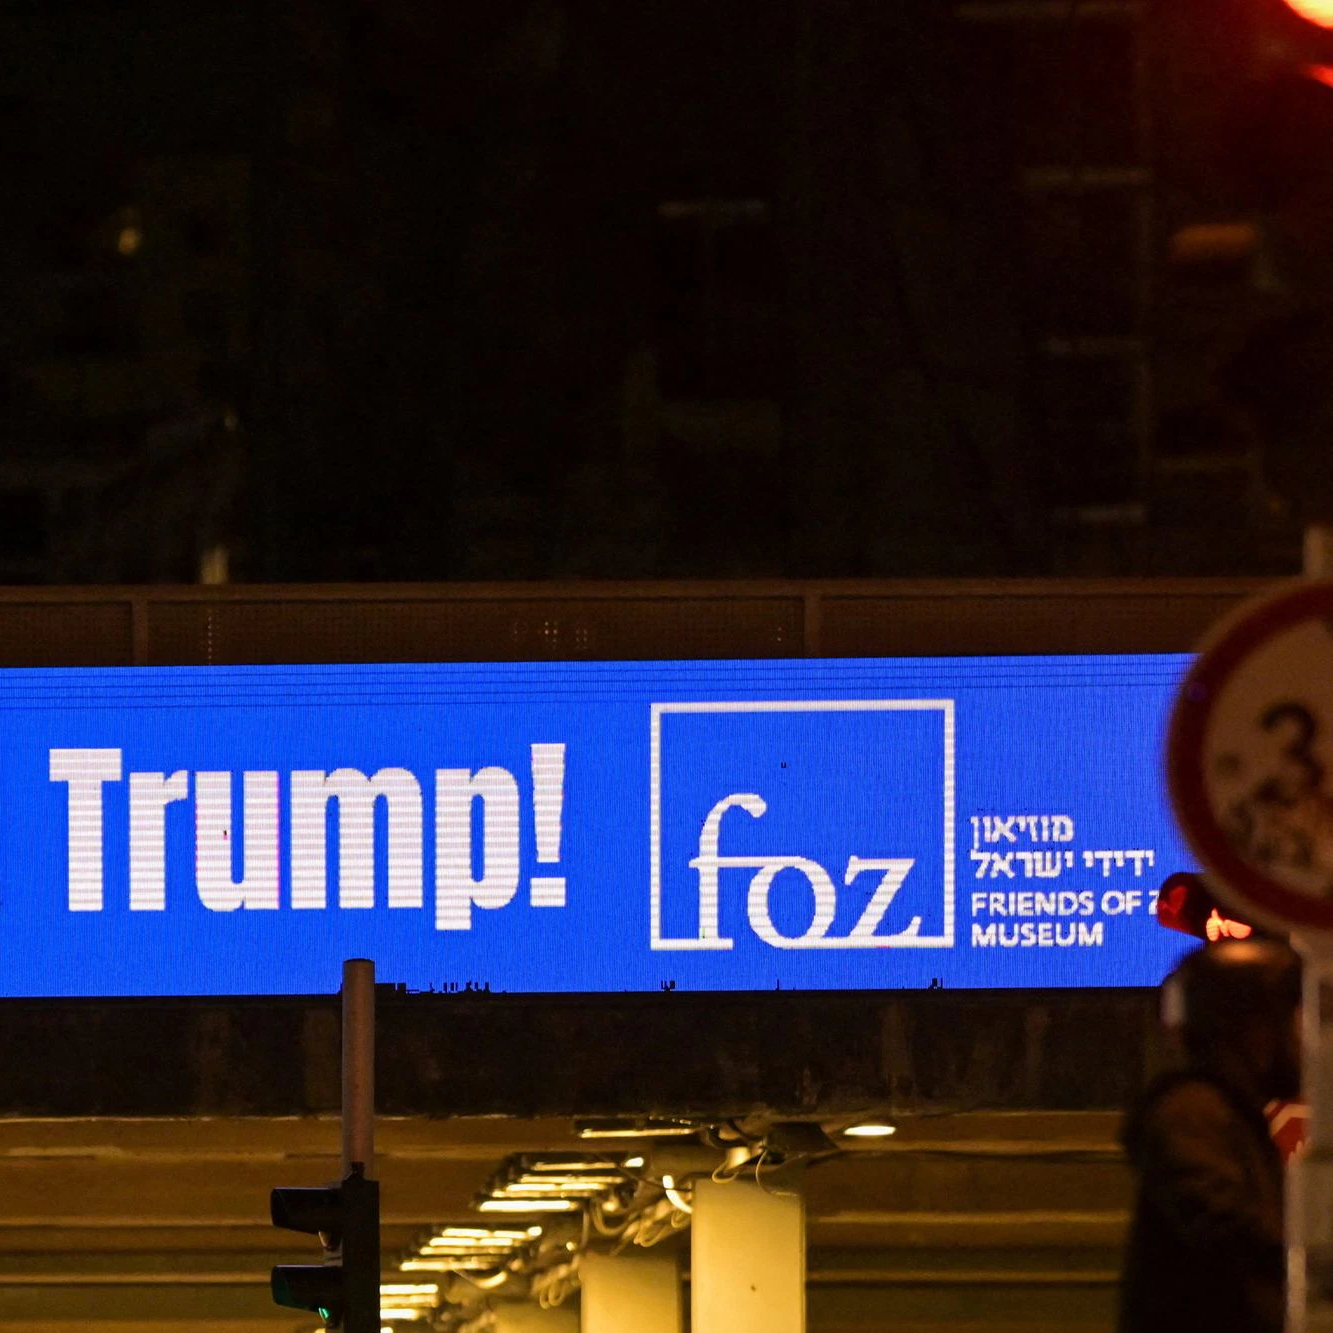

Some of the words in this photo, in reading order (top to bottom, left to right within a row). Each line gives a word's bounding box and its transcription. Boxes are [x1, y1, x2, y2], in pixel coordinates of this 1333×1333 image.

[49, 743, 567, 931] Trump!
[970, 815, 1074, 849] מוזיאון
[689, 793, 922, 947] foz
[970, 849, 1074, 879] ישראל
[1083, 849, 1155, 878] ידידי
[971, 891, 1094, 917] FRIENDS
[1101, 890, 1142, 916] OF
[971, 922, 1104, 948] MUSEUM
